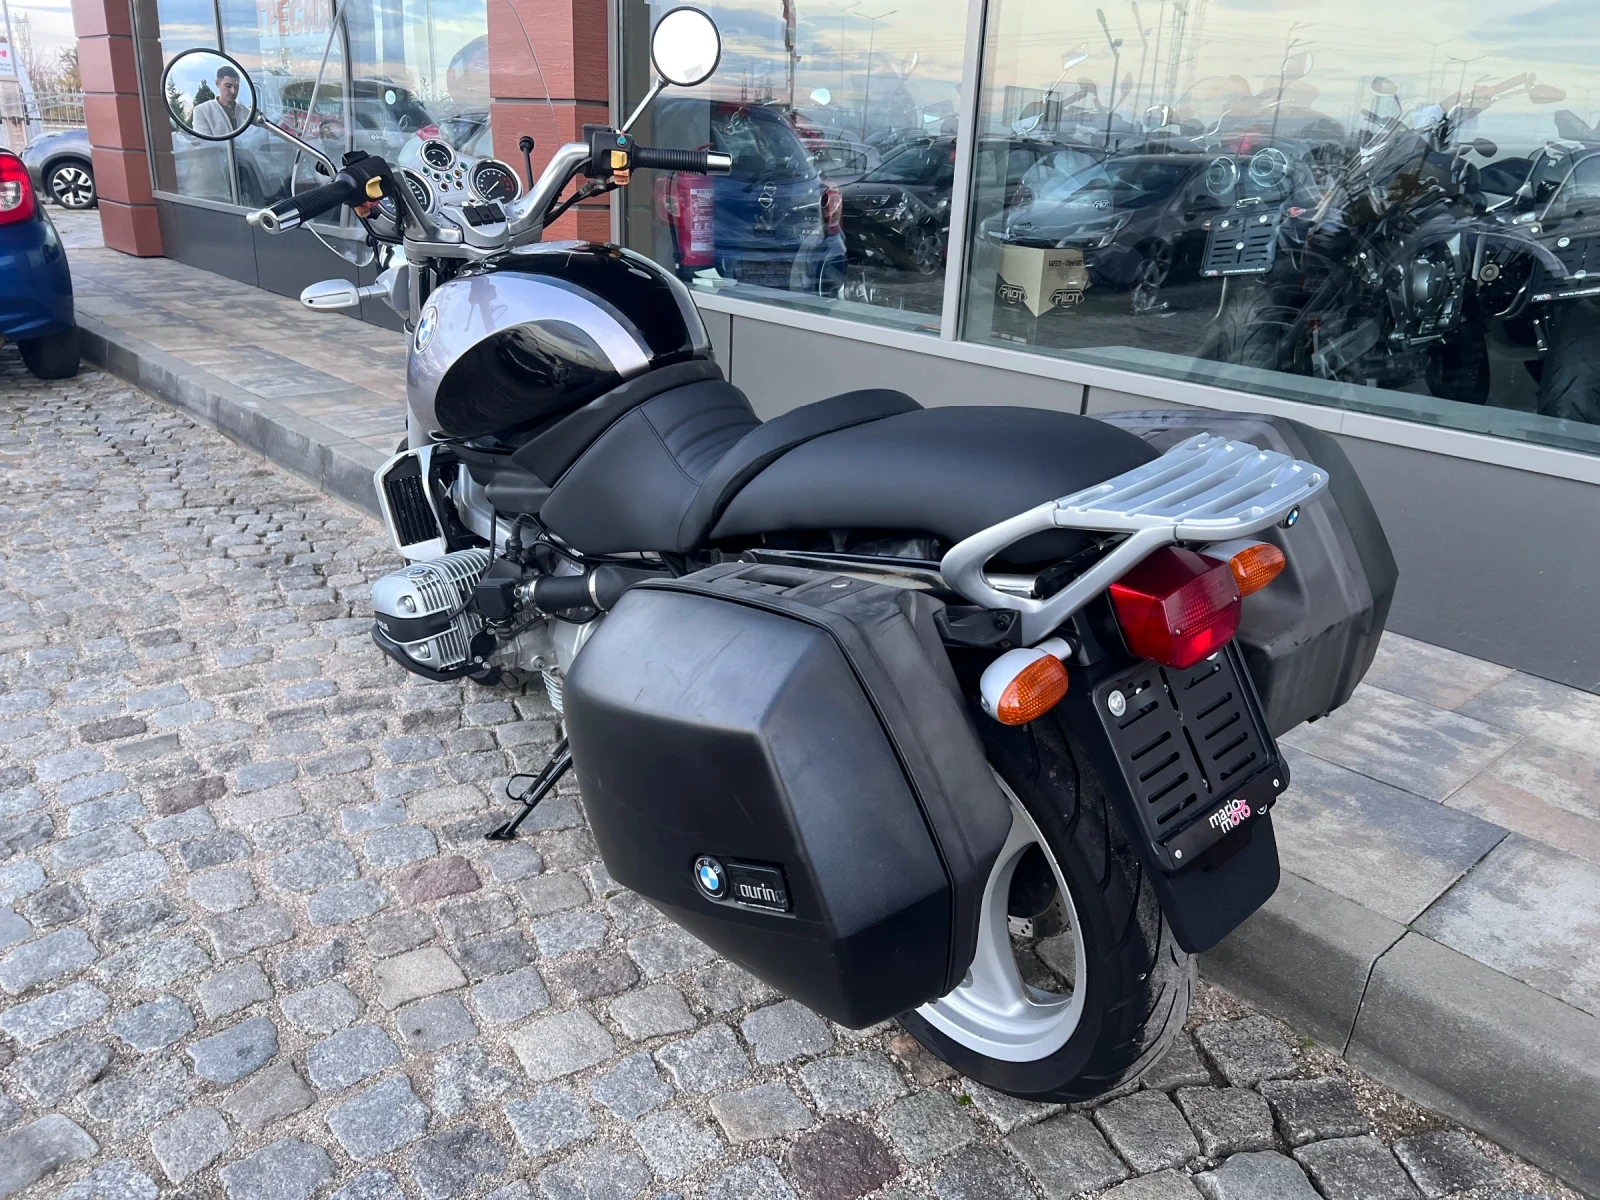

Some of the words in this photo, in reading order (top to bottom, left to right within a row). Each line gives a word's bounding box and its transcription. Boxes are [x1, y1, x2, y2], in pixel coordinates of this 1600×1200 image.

[1002, 288, 1023, 299] PILOT
[1055, 293, 1081, 304] PILOT
[1208, 799, 1240, 829] mario
[1221, 804, 1251, 834] moto
[696, 859, 721, 875] BMW
